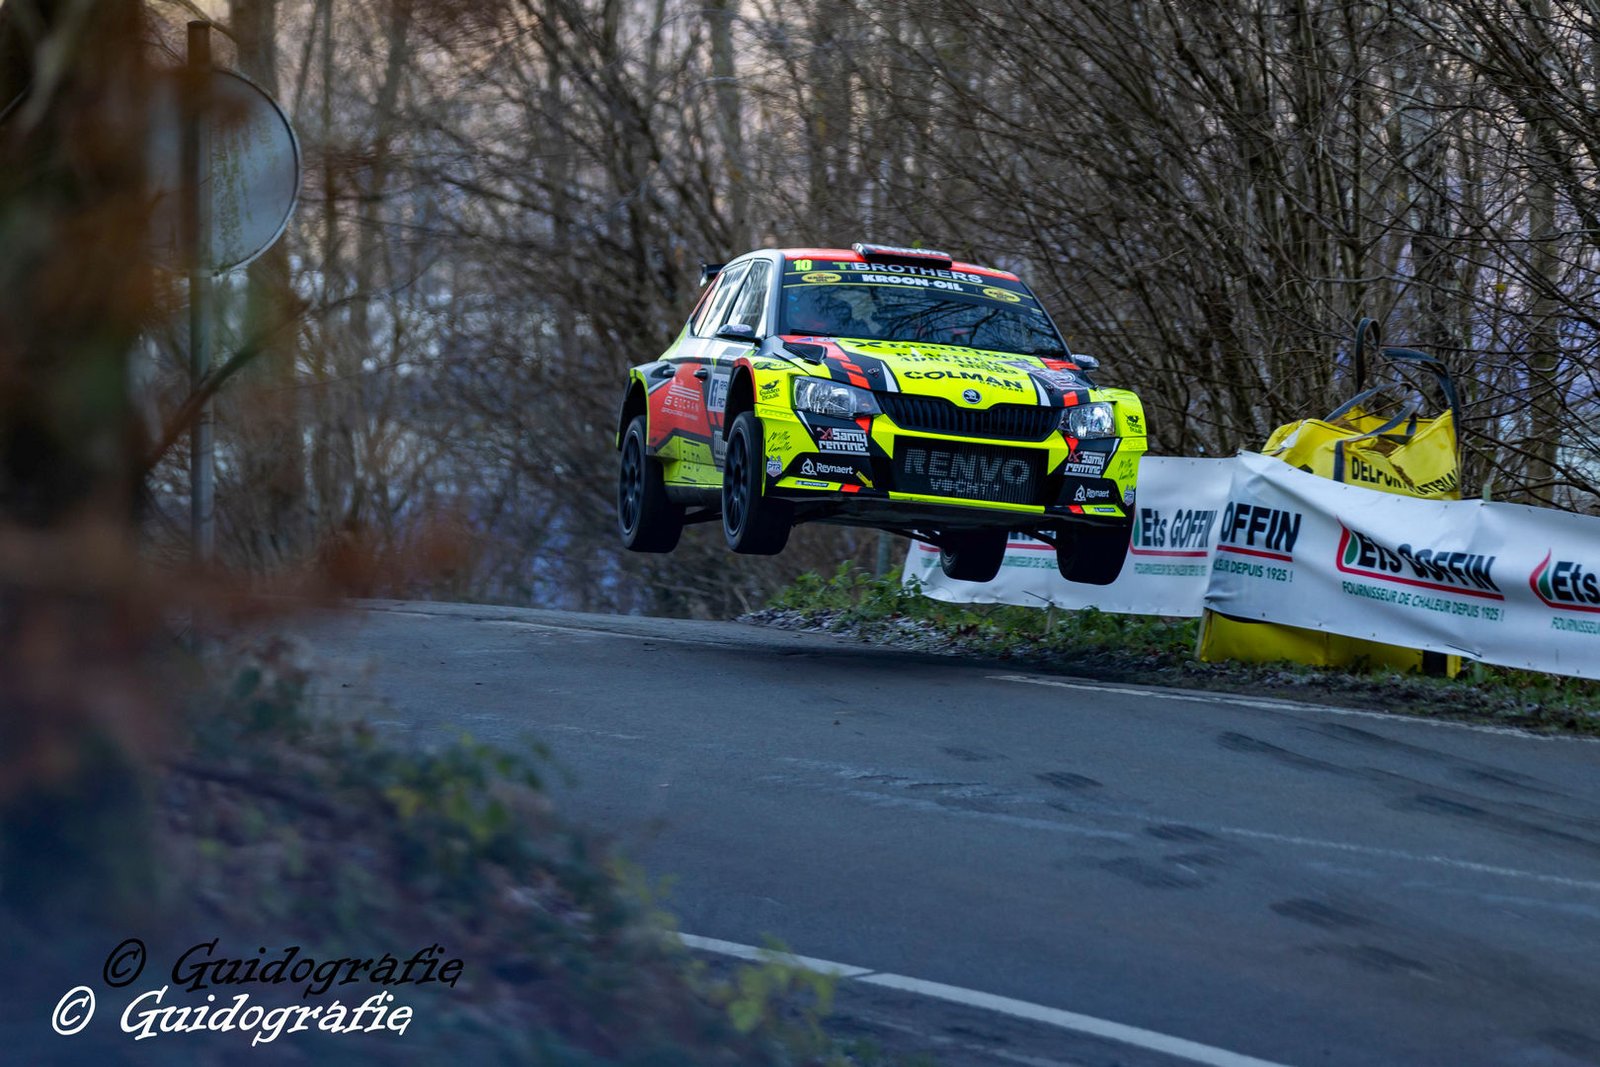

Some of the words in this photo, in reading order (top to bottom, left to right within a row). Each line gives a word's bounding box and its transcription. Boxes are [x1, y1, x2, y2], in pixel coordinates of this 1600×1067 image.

[792, 259, 813, 271] 10
[862, 273, 964, 292] KROON-OIL
[904, 370, 1025, 391] COLMAN
[816, 462, 854, 475] Reynaert
[904, 448, 1030, 484] RENVO
[1141, 508, 1168, 548] Ets
[1230, 560, 1264, 578] DEPUIS
[1266, 567, 1288, 582] 1925
[1552, 561, 1600, 604] Ets
[1342, 580, 1397, 602] FOURNISSEUR
[1399, 592, 1412, 606] DE
[1411, 594, 1451, 613] CHALEUR
[1451, 601, 1480, 618] DEPUIS
[1481, 606, 1500, 621] 1925
